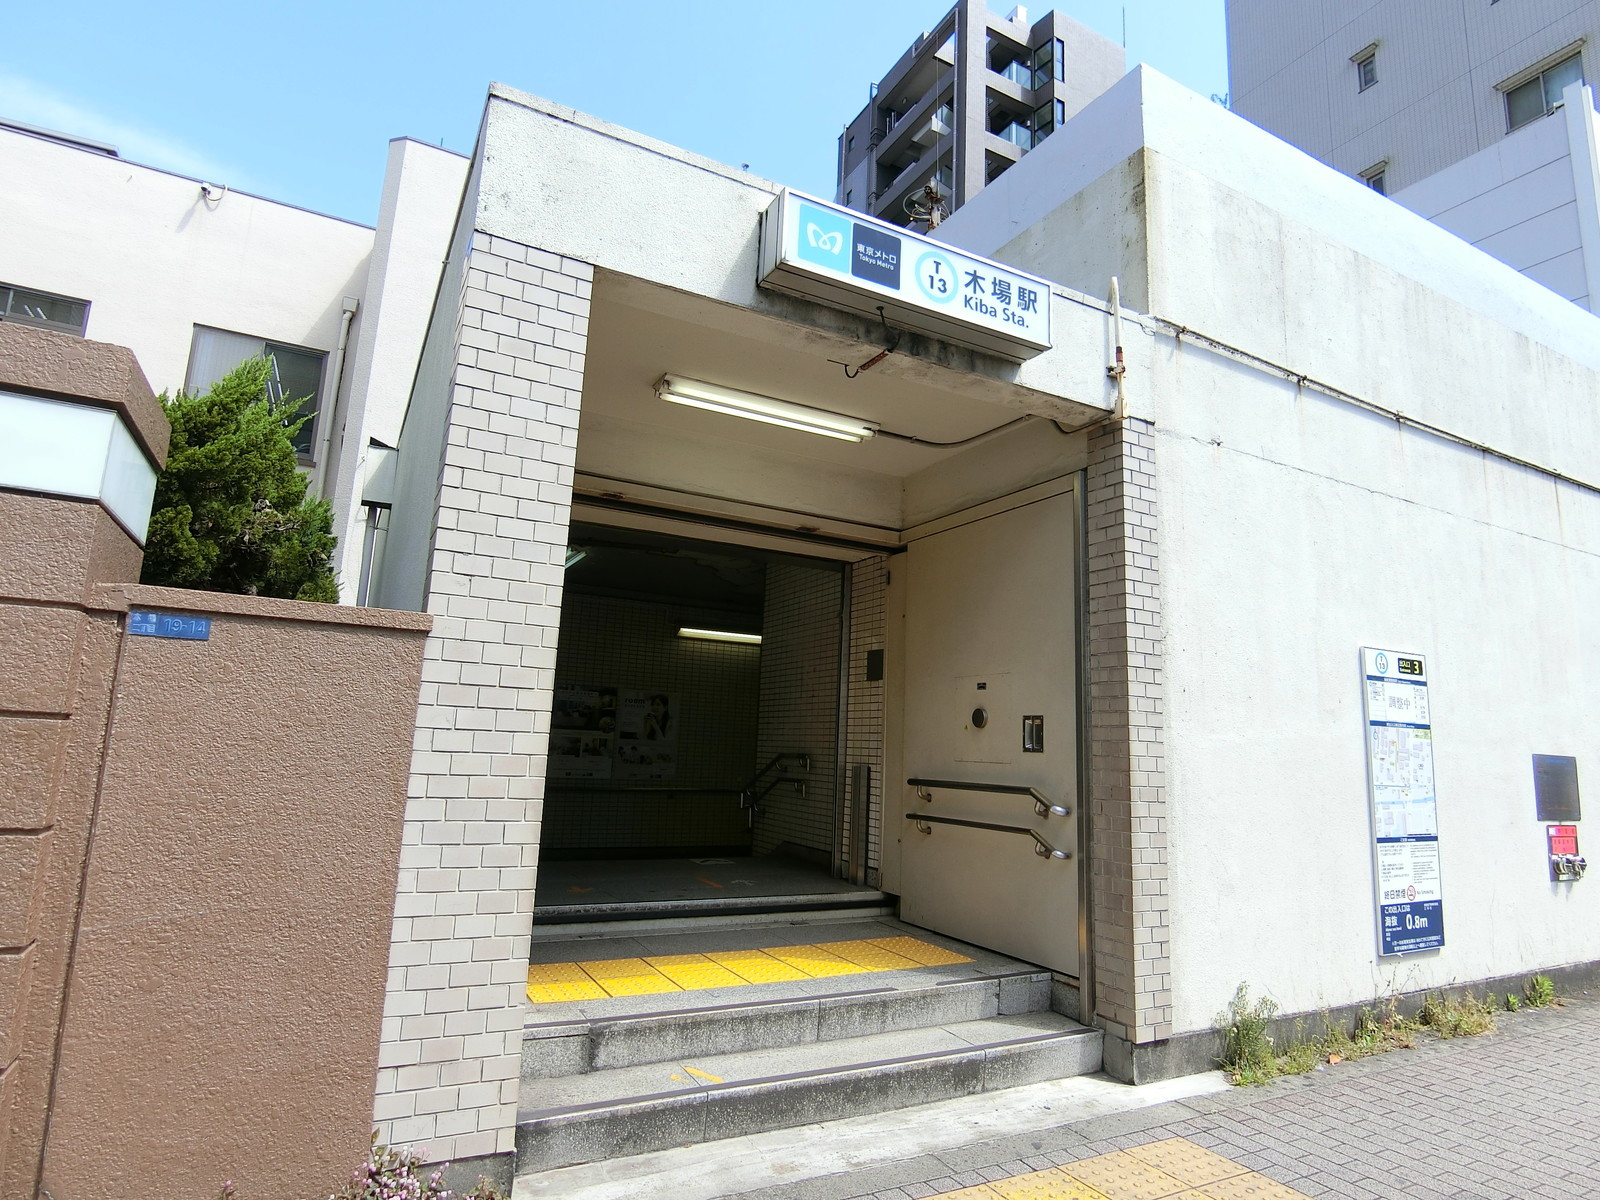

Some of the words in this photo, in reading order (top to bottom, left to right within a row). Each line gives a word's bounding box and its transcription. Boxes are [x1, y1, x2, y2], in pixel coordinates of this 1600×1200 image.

[856, 243, 897, 264] 東京メトロ
[858, 253, 876, 265] Tokyo
[876, 259, 894, 271] Metro
[933, 260, 942, 275] T
[928, 275, 948, 294] 13
[964, 269, 1038, 314] 木場駅
[964, 294, 997, 318] Kiba
[1002, 307, 1029, 329] Sta.
[164, 618, 206, 634] 19-14
[1378, 662, 1386, 670] 13
[1413, 660, 1420, 674] 3
[1405, 913, 1429, 930] 0.8m
